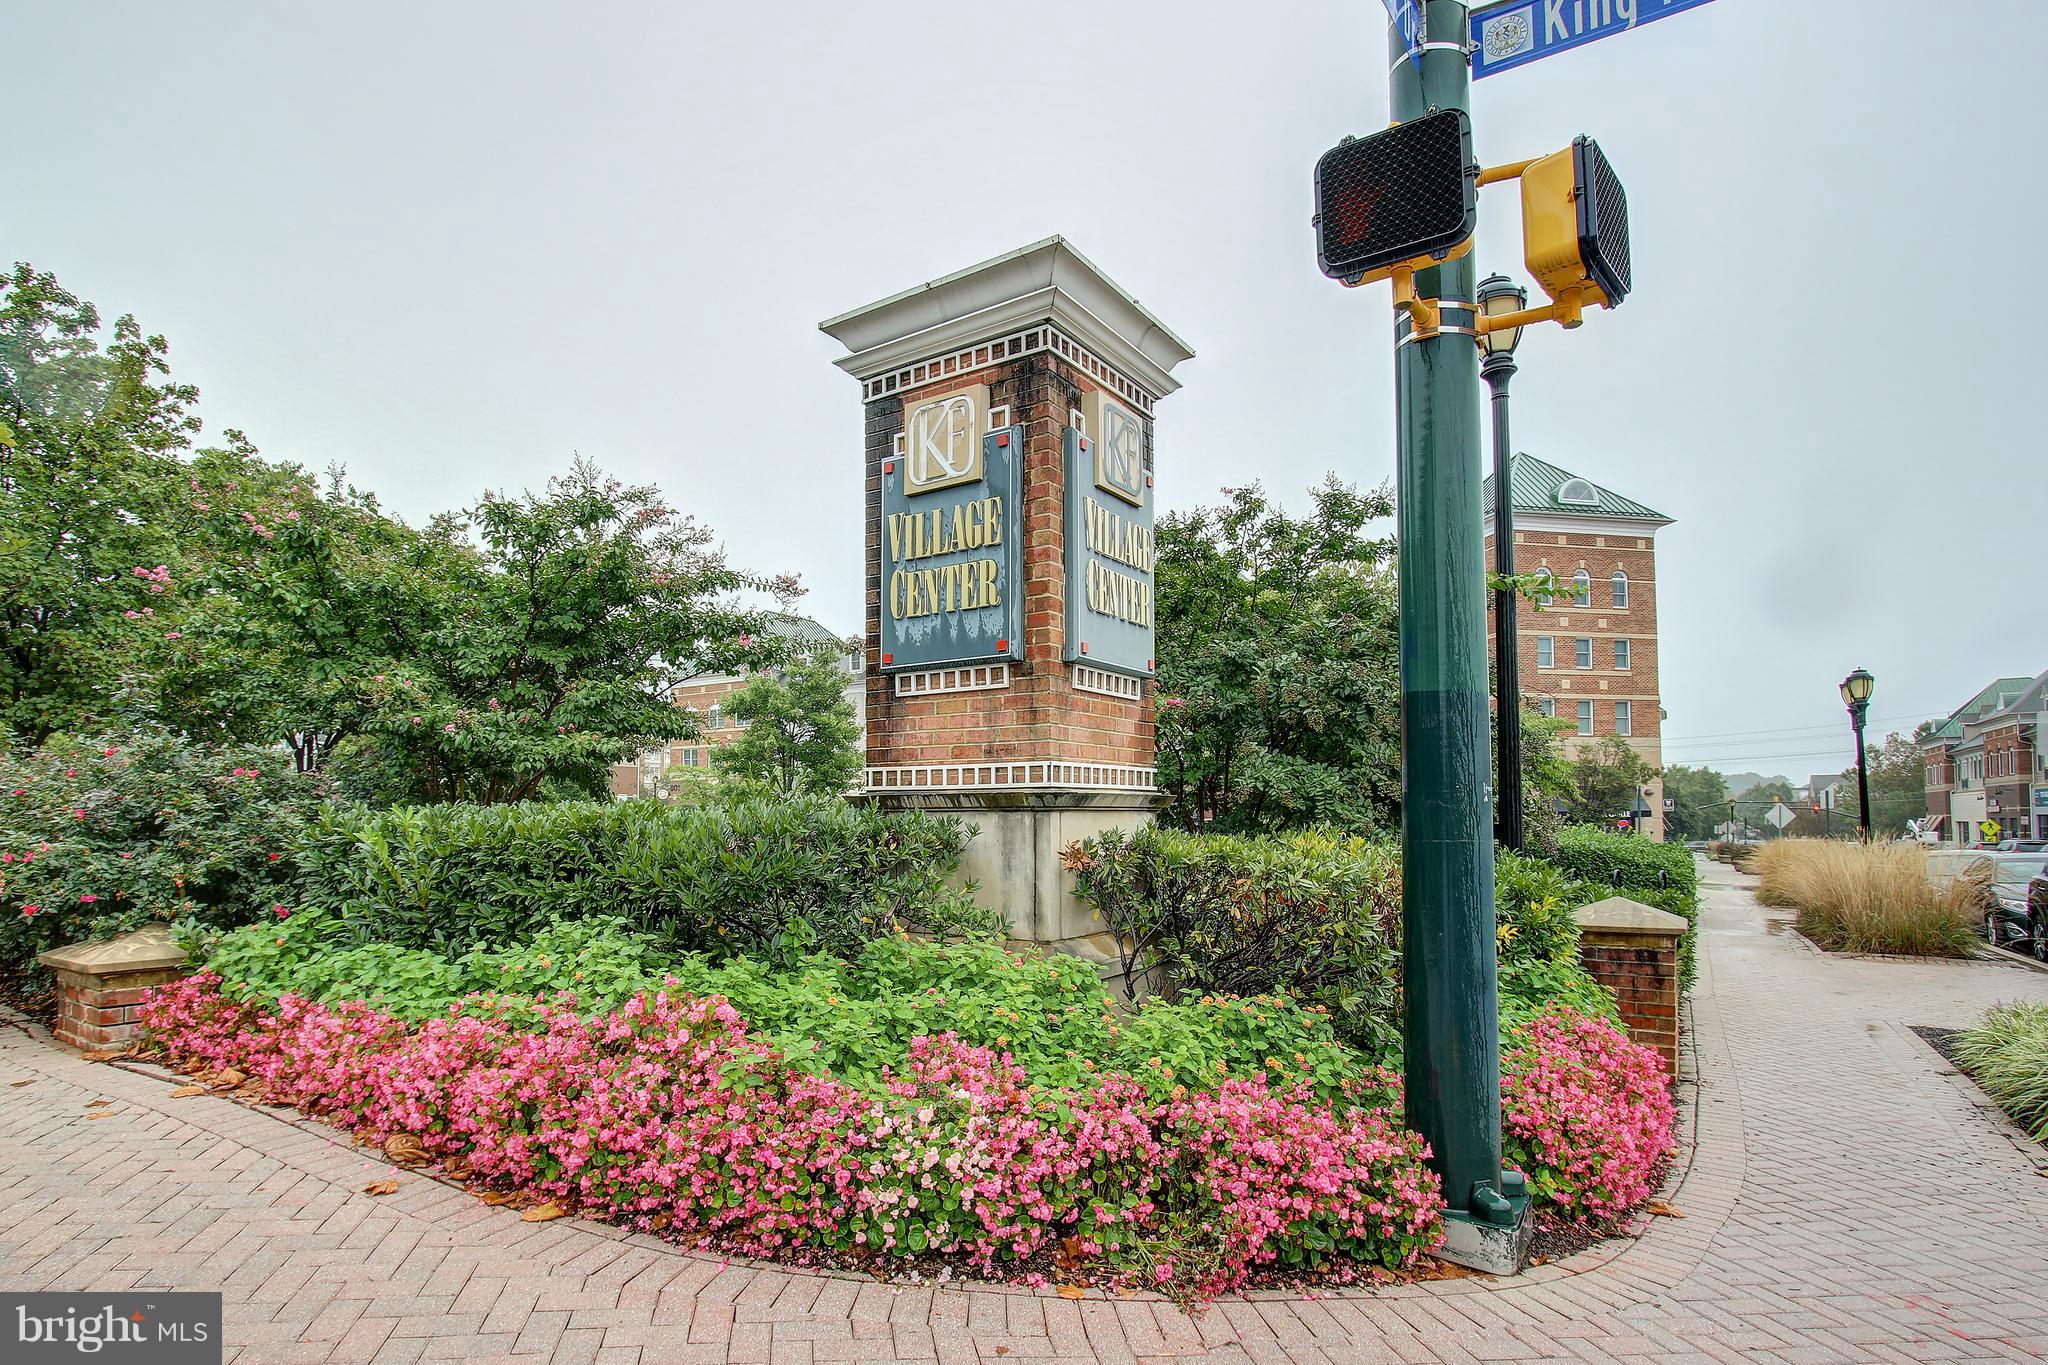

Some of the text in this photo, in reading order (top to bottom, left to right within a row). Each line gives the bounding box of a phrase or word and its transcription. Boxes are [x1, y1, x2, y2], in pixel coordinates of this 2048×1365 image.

[1544, 0, 1638, 45] King
[888, 496, 1003, 562] VILLAGE
[1084, 496, 1152, 574] VILLAGE
[890, 559, 1002, 620] CENTER
[1087, 558, 1152, 628] CENTER
